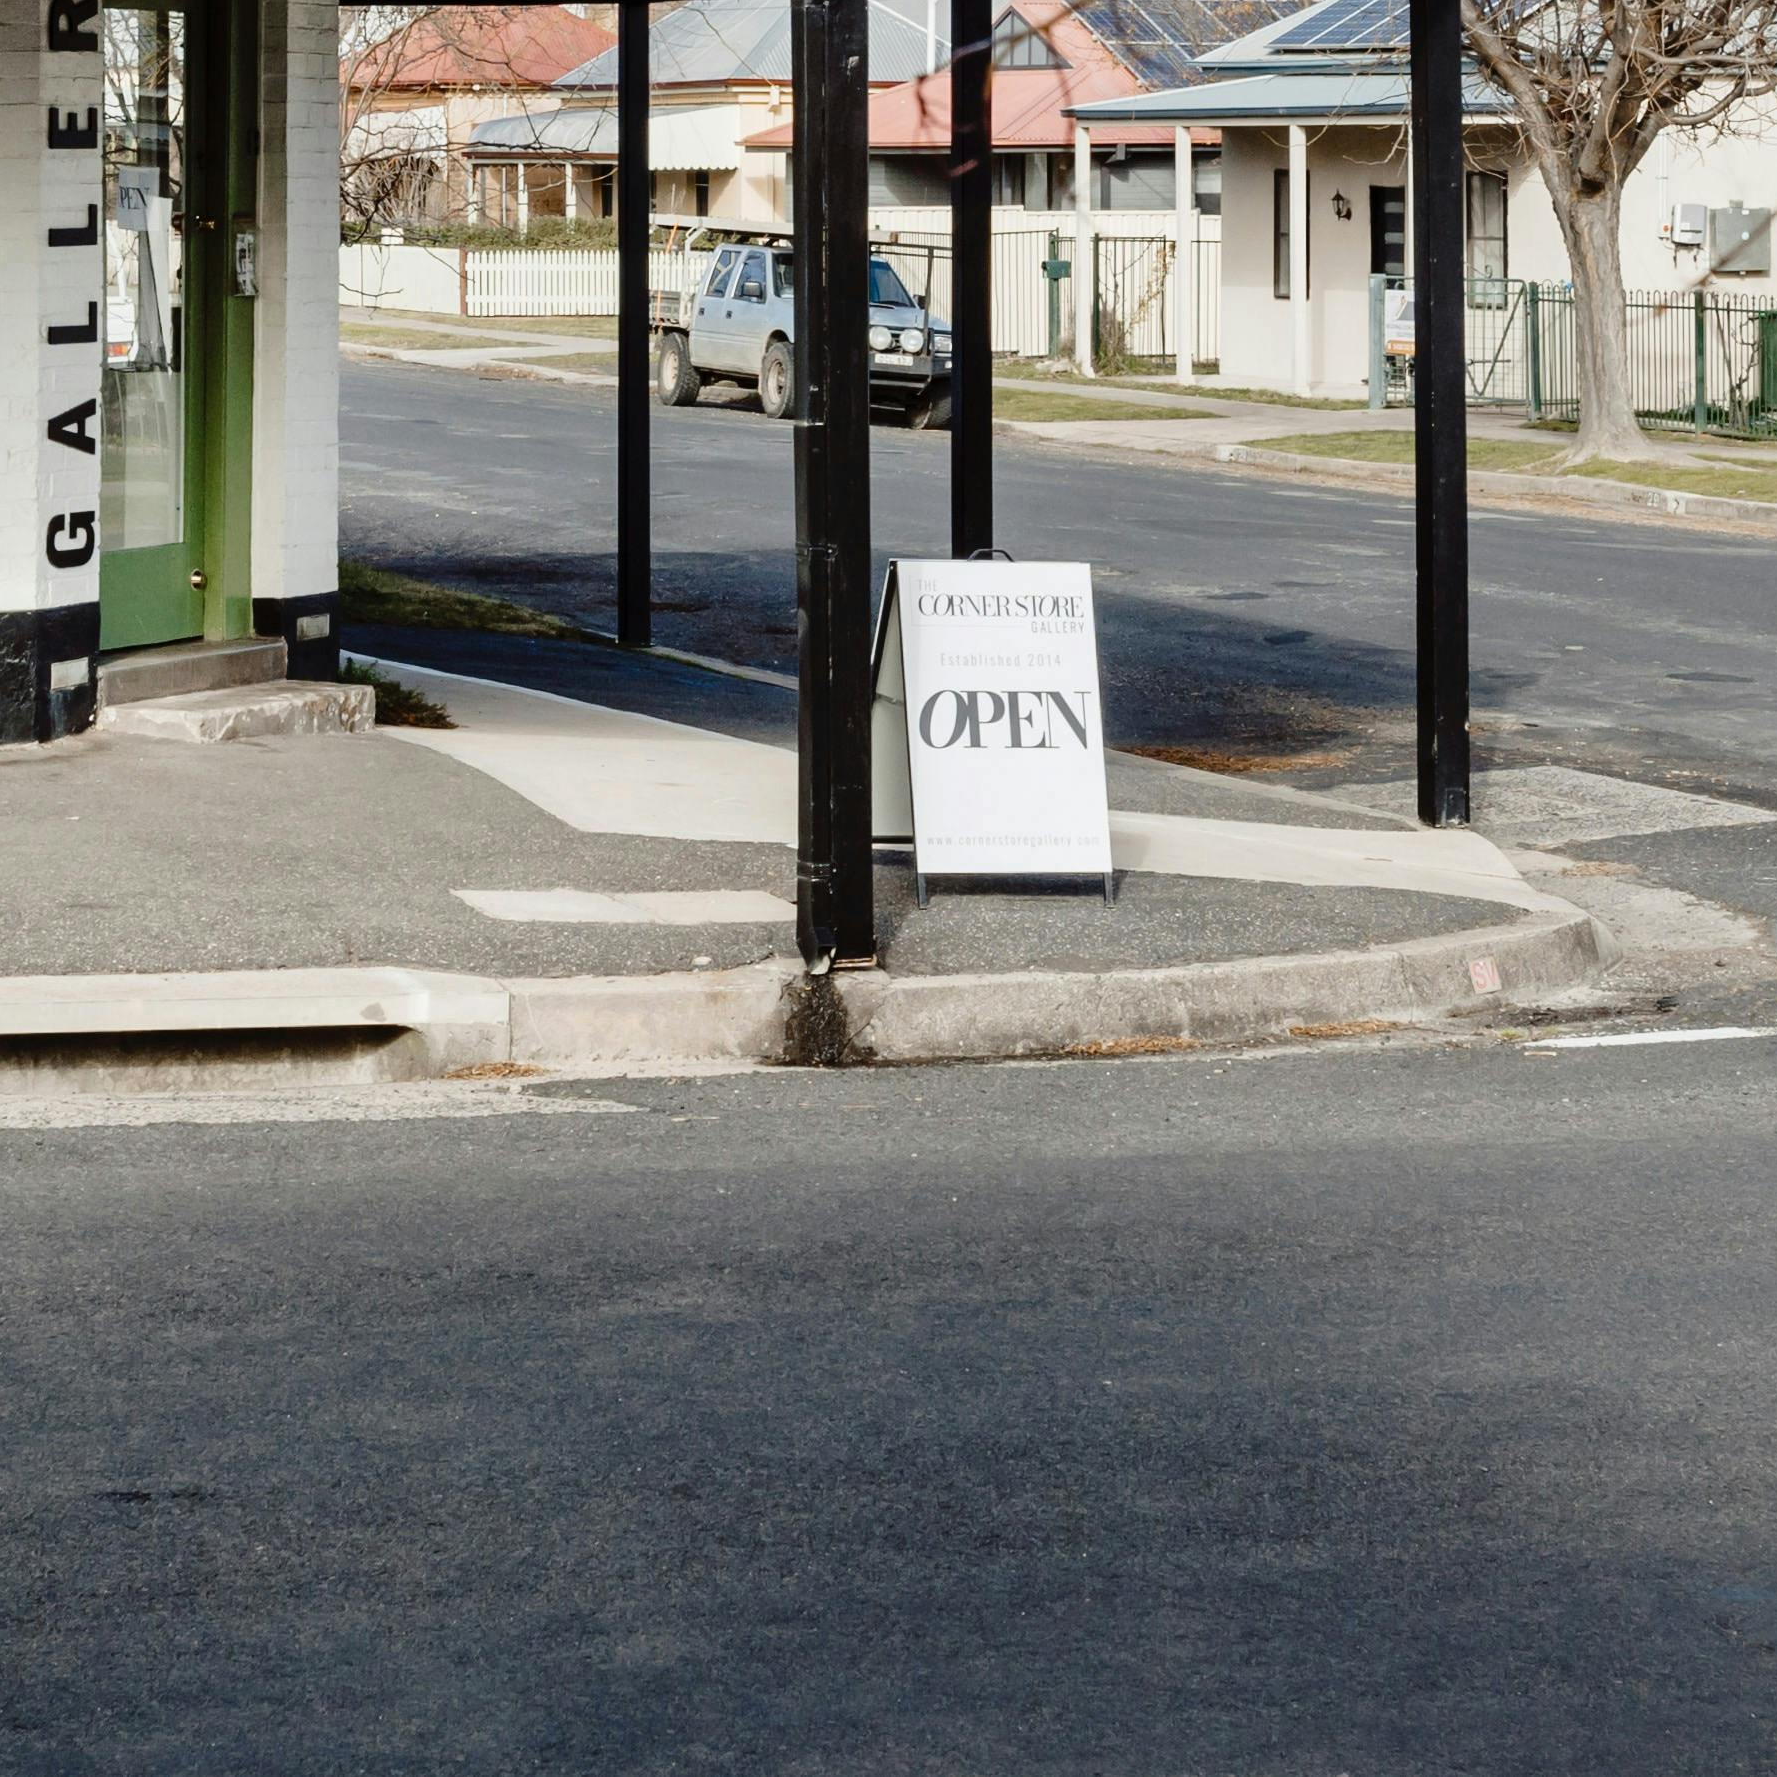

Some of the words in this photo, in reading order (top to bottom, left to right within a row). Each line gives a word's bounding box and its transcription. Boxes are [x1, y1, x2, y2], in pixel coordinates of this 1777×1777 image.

[119, 186, 150, 209] PEN
[917, 579, 938, 592] THE
[918, 593, 1011, 618] CORNER
[1015, 594, 1085, 618] STORE
[1031, 621, 1085, 634] GALLERY
[940, 653, 1021, 667] Established
[1028, 653, 1062, 667] 2014
[919, 689, 1092, 750] OPEN
